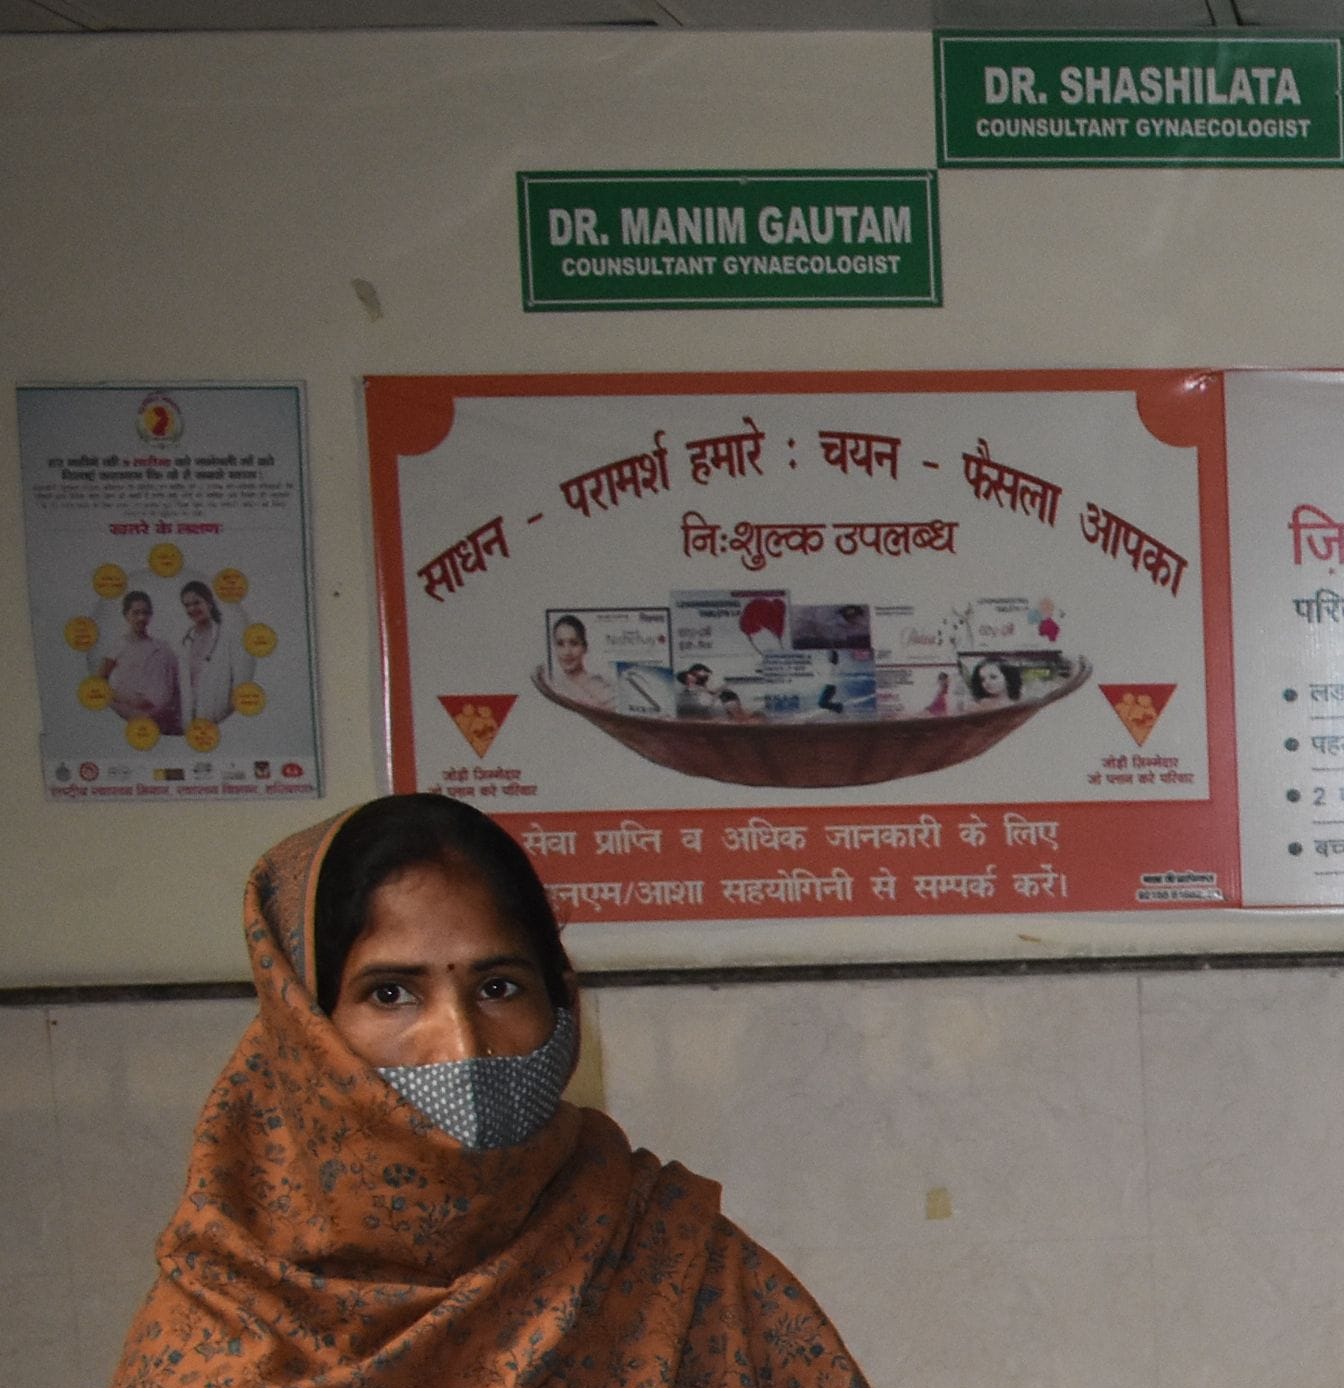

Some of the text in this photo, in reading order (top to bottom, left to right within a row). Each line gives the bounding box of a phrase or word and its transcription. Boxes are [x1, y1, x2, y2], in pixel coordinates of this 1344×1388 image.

[984, 66, 1301, 106] DR. SHASHILATA
[976, 118, 1312, 139] COUNSULTANT GYNAECOLOGIST
[549, 205, 914, 246] DR. MANIM GAUTAM
[561, 254, 901, 277] COUNSULTANT GYNAECOLOGIST
[418, 416, 1188, 602] साधन परामर्श हमारे चयन फैसला आपका
[833, 518, 959, 557] उपलब्ध
[522, 813, 1060, 857] सेवा प्राप्ति व अधिक जानकारी के लिए
[720, 867, 855, 903] सहयोगिनी
[870, 867, 897, 901] से
[914, 865, 997, 901] सम्पर्क
